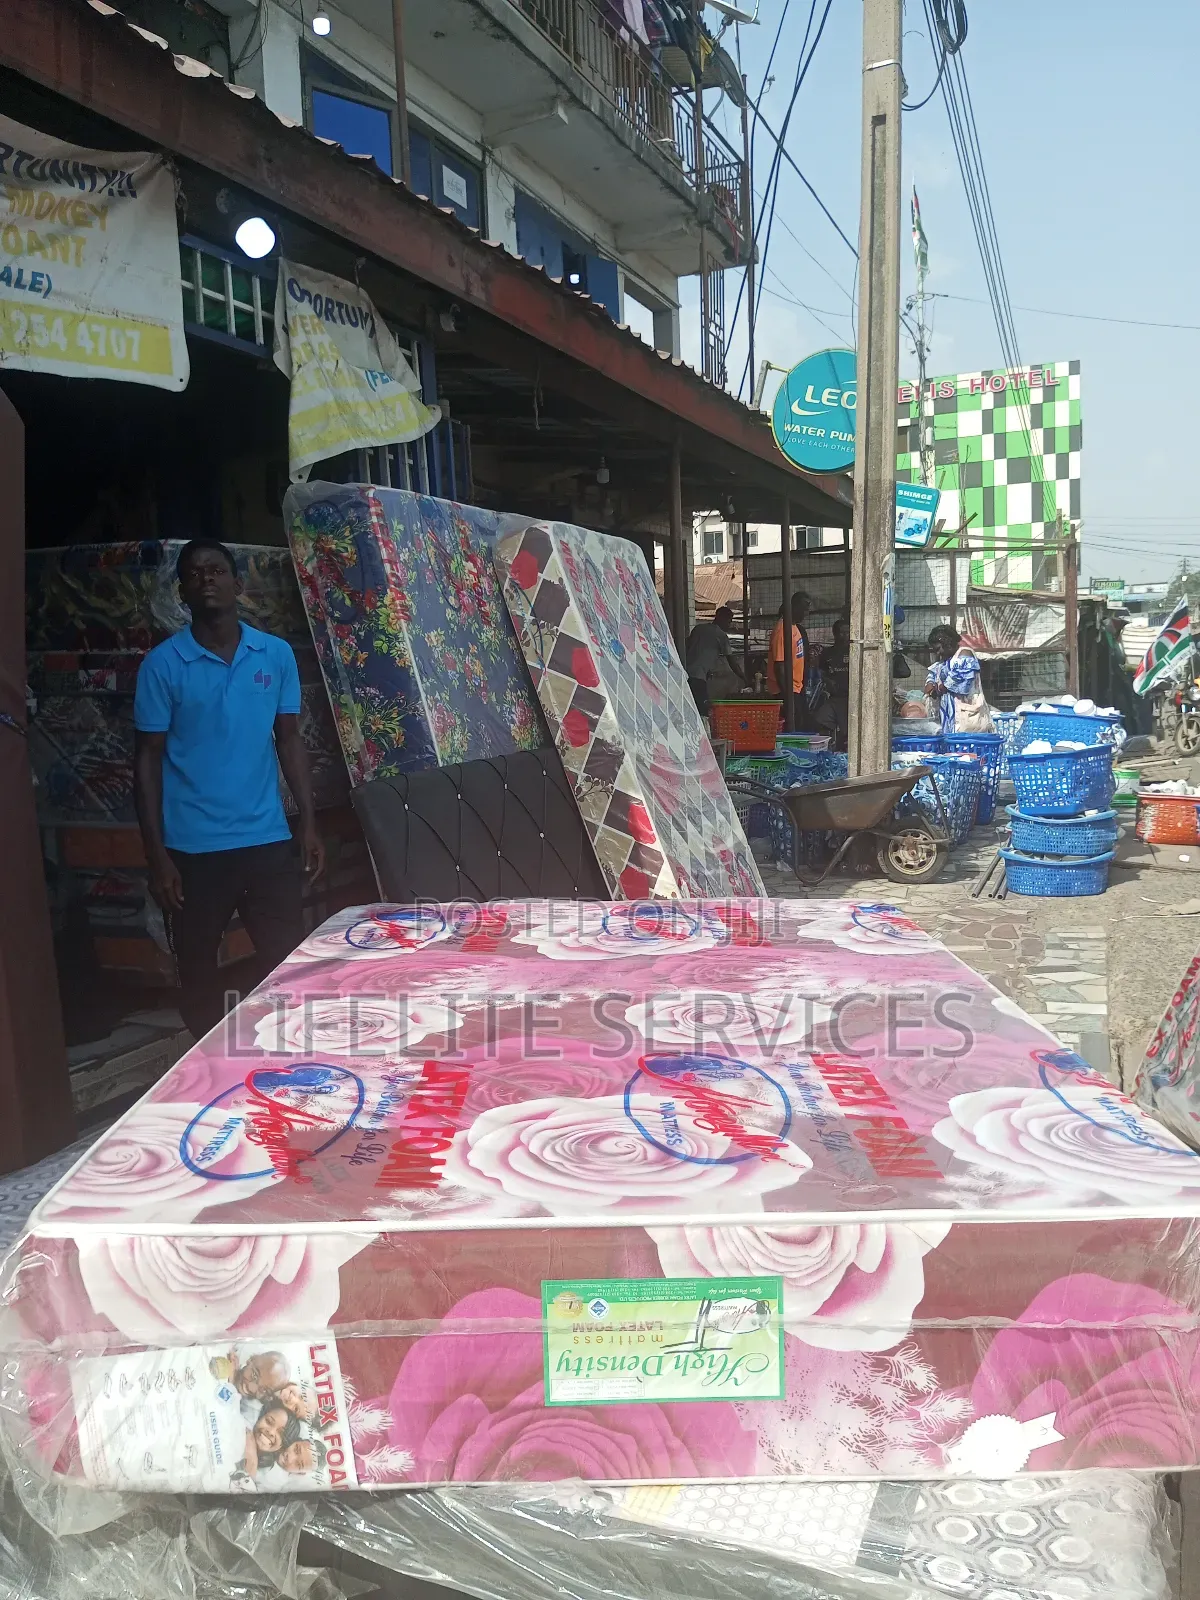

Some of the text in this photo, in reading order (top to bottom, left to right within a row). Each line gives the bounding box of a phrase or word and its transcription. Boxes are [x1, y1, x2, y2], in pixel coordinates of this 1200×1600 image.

[76, 321, 141, 363] 4707
[970, 369, 1060, 395] HOTEL
[784, 422, 826, 438] WATER
[787, 436, 806, 446] LOVE
[808, 440, 828, 450] EACH
[195, 1116, 244, 1163] MATTRESS
[374, 1060, 475, 1189] LATEX FOAM
[843, 1112, 945, 1179] FOAM
[572, 1320, 664, 1333] LATEX FOAM
[309, 1344, 339, 1428] LATEX
[555, 1346, 770, 1387] High Density
[209, 1411, 224, 1465] USER GUIDE
